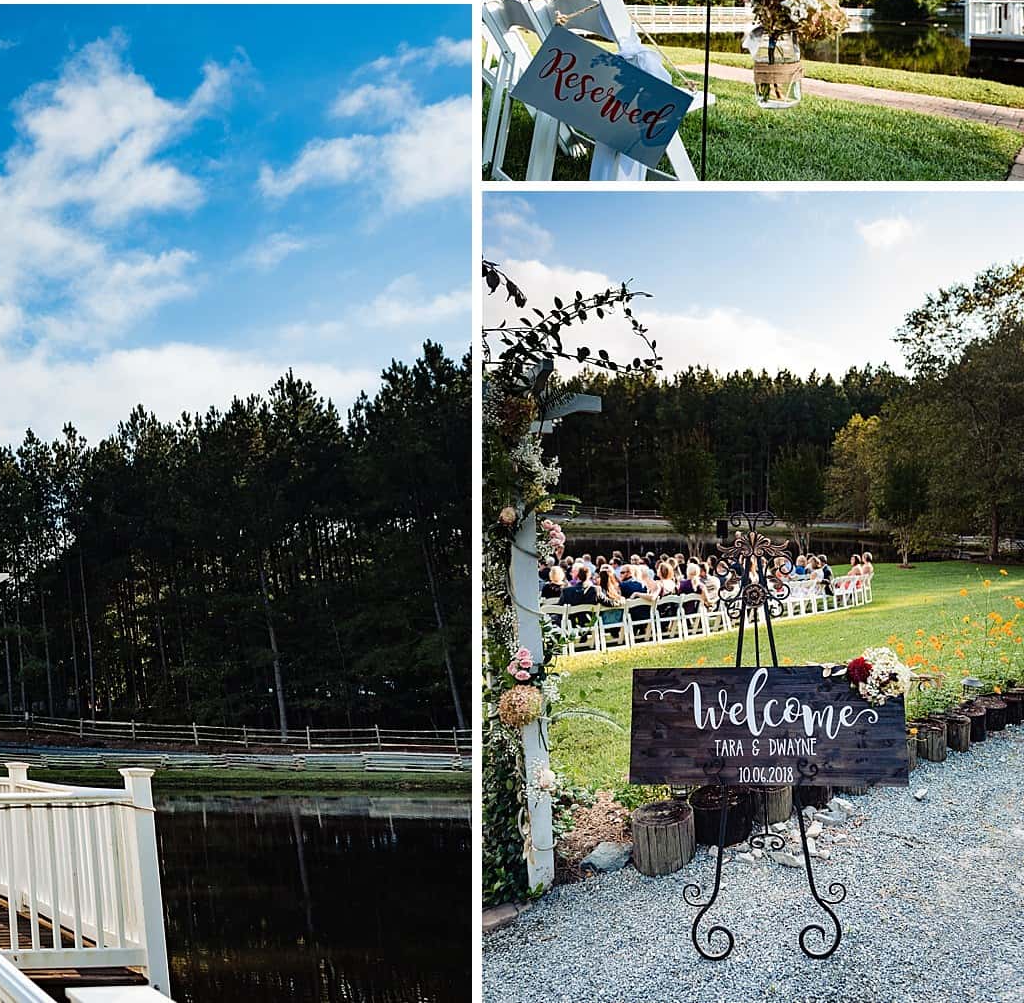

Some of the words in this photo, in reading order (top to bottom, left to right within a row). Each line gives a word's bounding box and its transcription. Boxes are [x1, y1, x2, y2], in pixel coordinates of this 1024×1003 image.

[539, 47, 676, 139] Reserved
[644, 668, 879, 739] Welcome
[715, 740, 743, 757] TARA
[752, 739, 761, 755] &
[770, 738, 817, 756] DWAYNE
[738, 767, 794, 783] 10.06.2018
